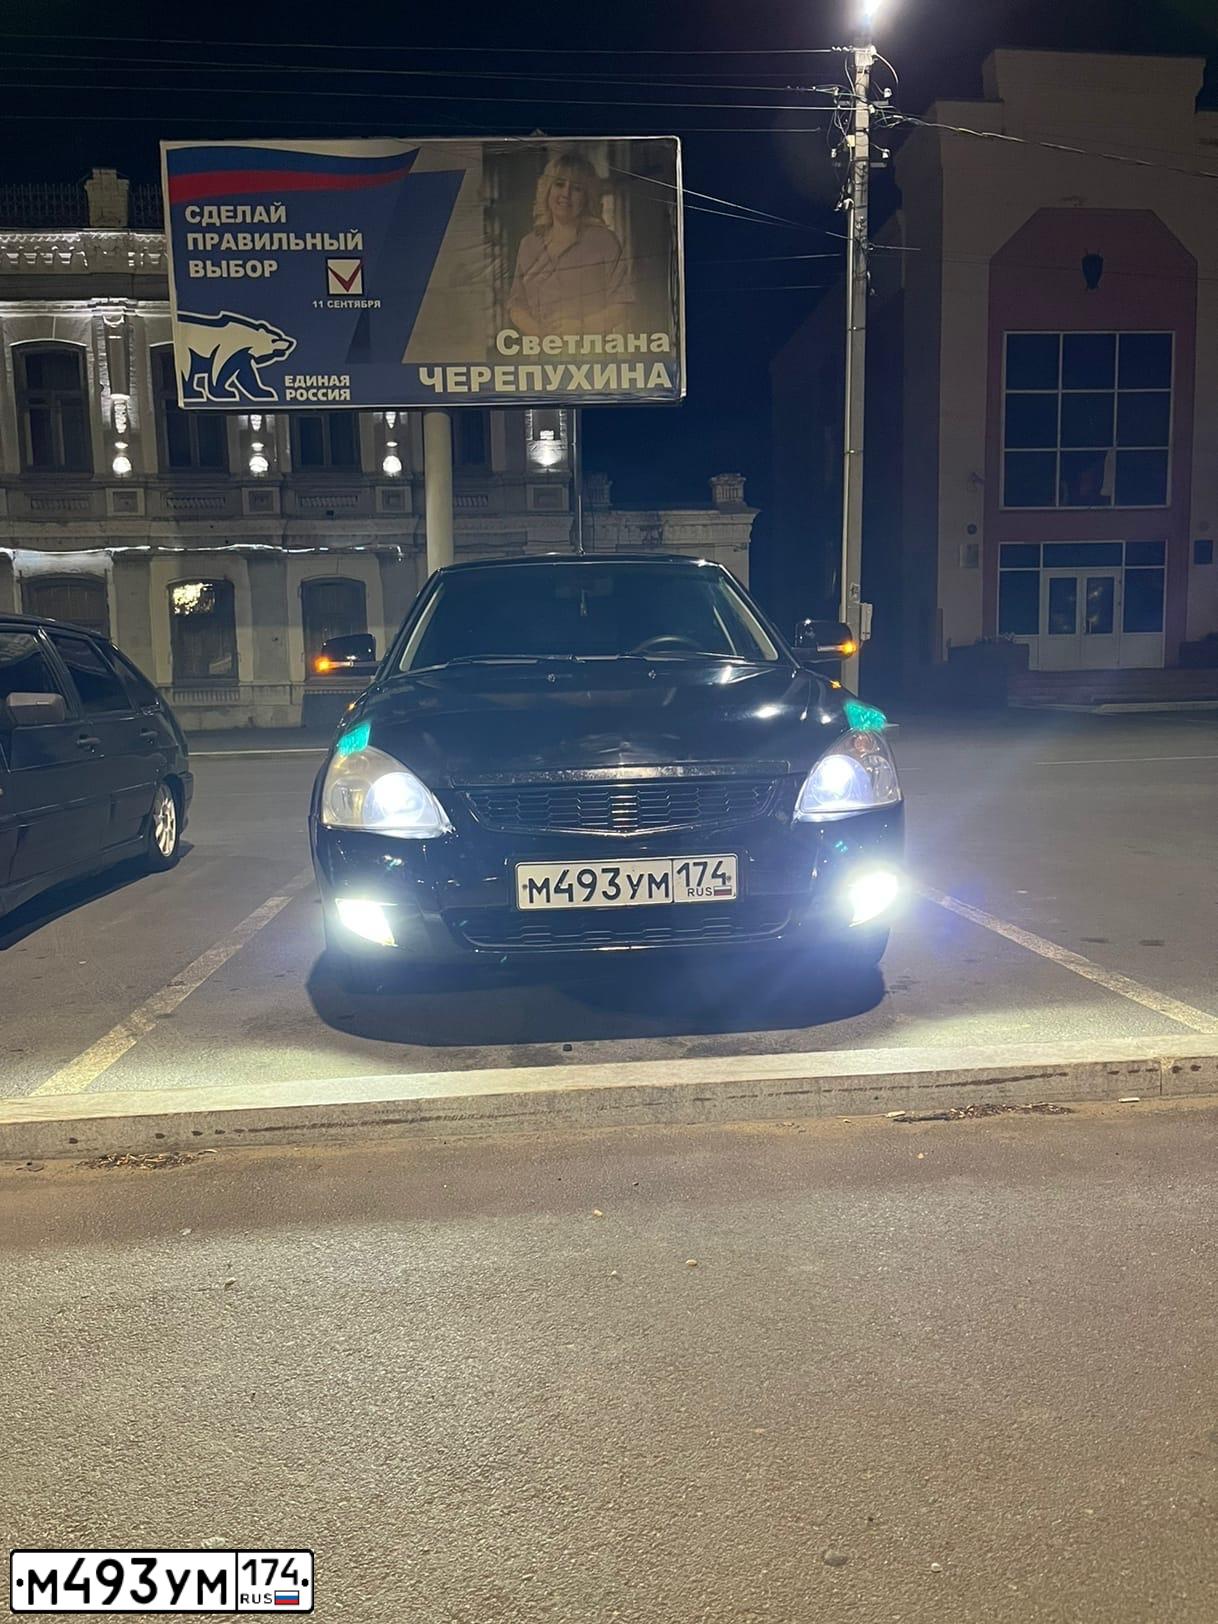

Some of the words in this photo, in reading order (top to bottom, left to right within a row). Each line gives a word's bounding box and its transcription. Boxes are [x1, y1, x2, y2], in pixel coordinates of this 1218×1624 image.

[185, 201, 287, 226] СДЕЛАЙ
[187, 228, 363, 250] ПРАВИЛЬНЫЙ
[189, 259, 278, 278] ВЫБОР
[312, 300, 324, 308] 11
[326, 300, 382, 309] СЕНТЯБРЯ
[496, 328, 671, 356] Светлана
[284, 375, 351, 388] ЕДИНАЯ
[418, 362, 673, 393] ЧЕРЕПУХИНА
[285, 388, 351, 401] РОССИЯ
[676, 860, 727, 888] 174
[687, 886, 713, 897] RUS
